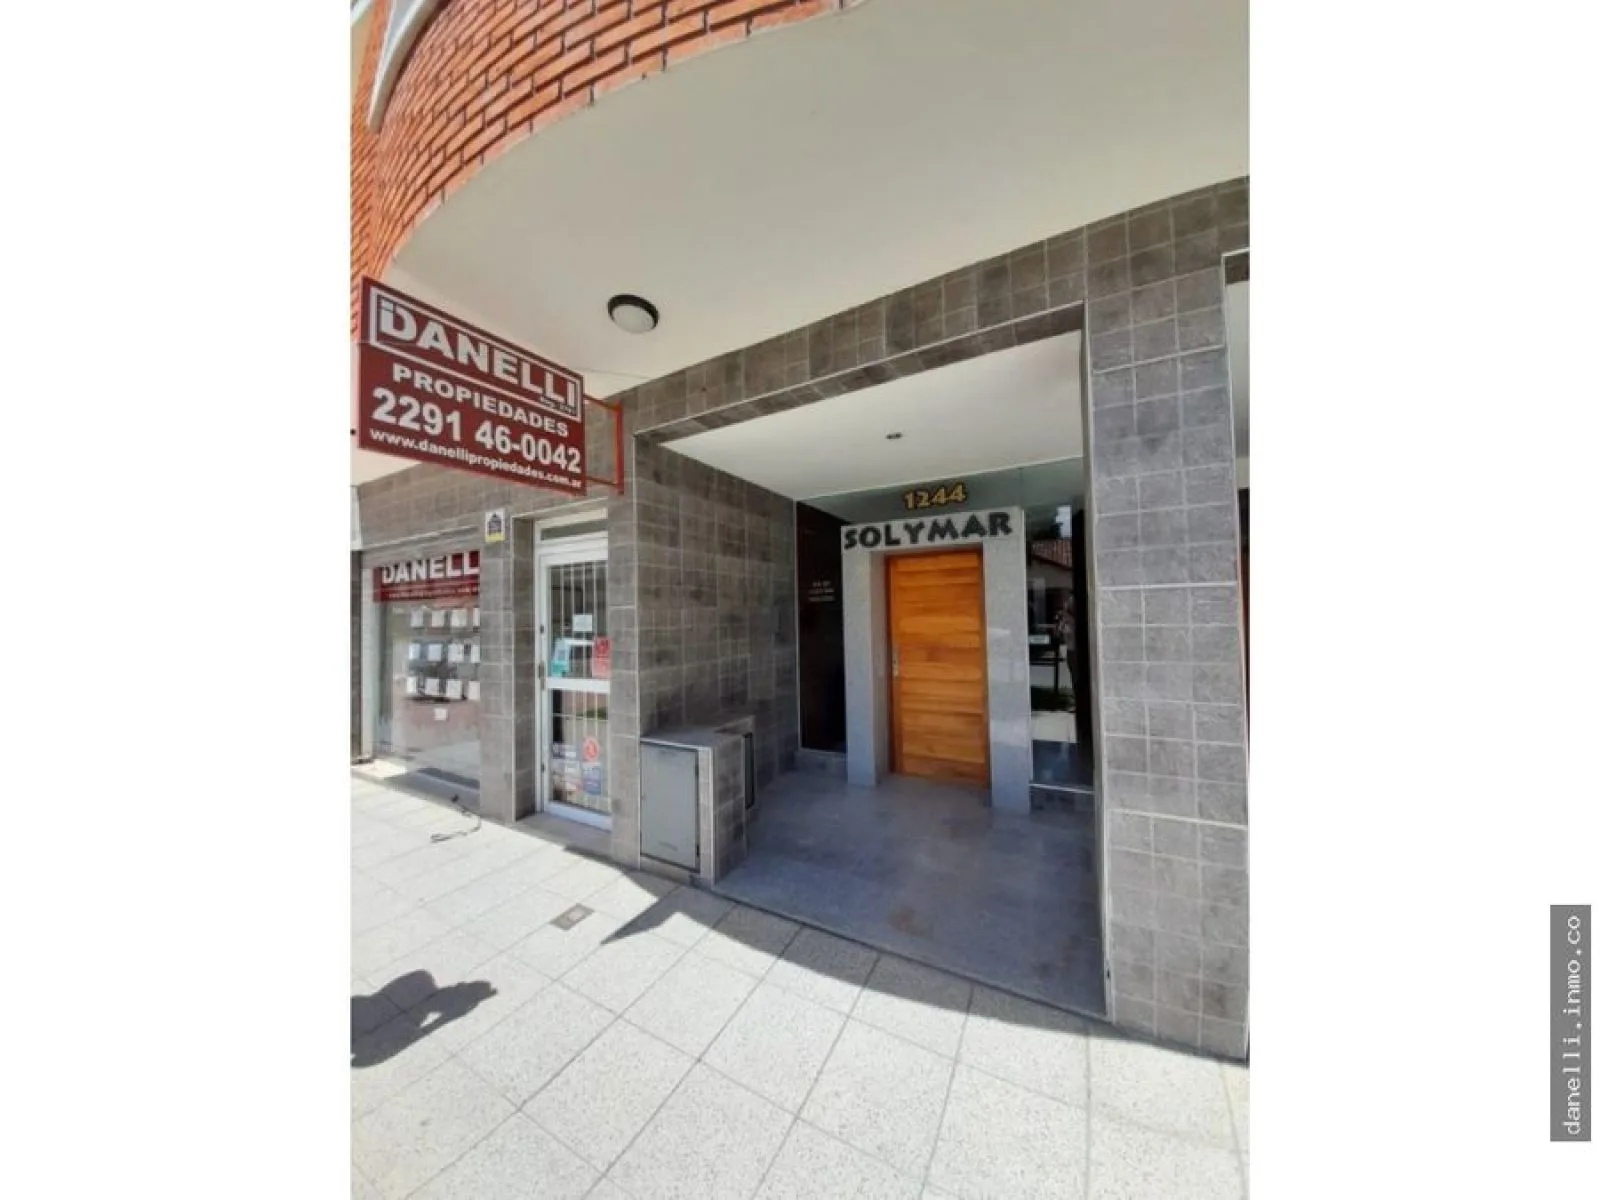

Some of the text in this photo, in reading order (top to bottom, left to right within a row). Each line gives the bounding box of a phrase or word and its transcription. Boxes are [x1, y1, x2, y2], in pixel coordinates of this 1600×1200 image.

[379, 299, 576, 408] DANELLI
[372, 387, 582, 474] 2291 46-0042
[393, 363, 569, 437] PROPIEDADES
[370, 428, 582, 488] www.danellipropiedades.com.ar
[904, 482, 967, 509] 1244
[844, 512, 1012, 549] SOLYMAR
